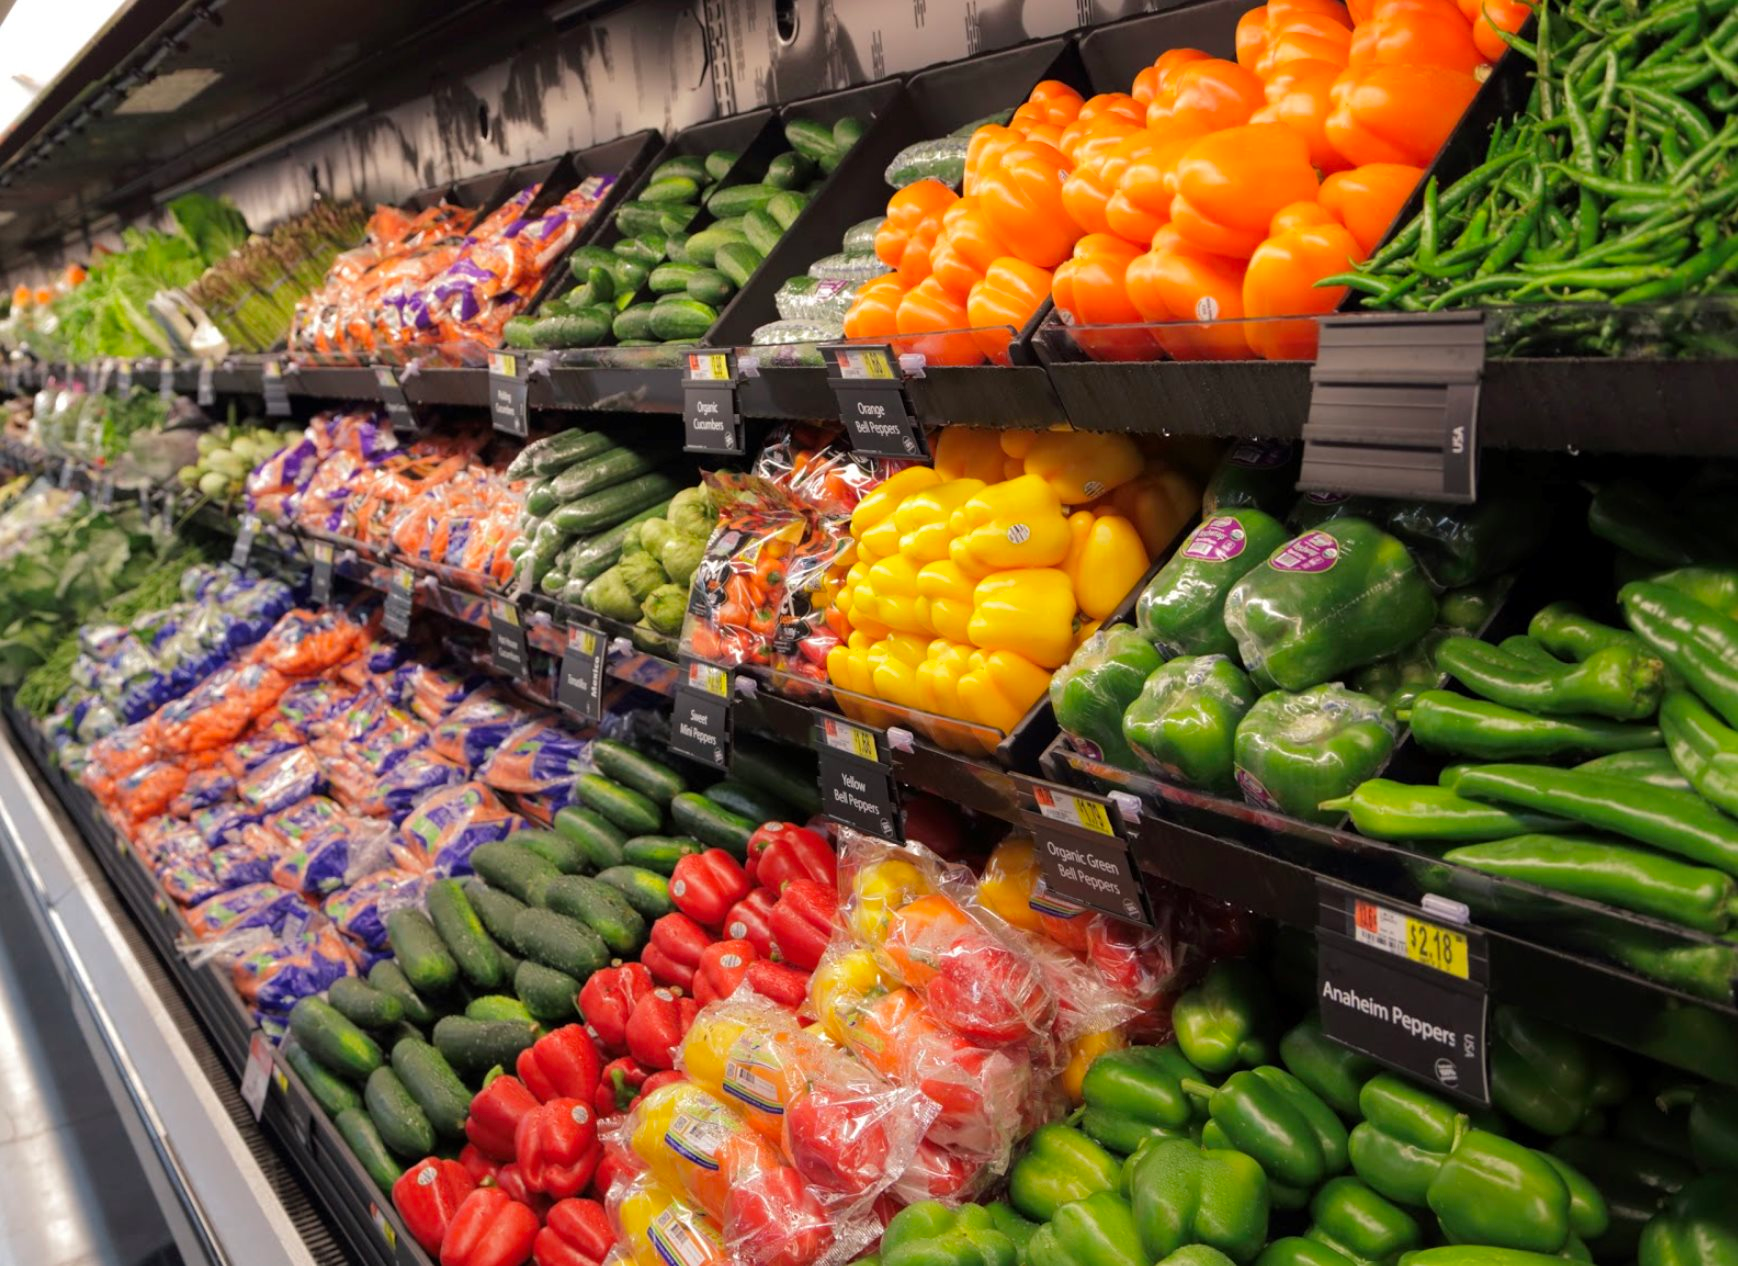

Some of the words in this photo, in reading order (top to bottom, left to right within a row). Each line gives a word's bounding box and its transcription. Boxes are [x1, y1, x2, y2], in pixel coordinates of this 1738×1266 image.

[697, 401, 719, 416] Organic
[857, 402, 885, 419] Orange
[693, 418, 724, 431] Cucumbers
[855, 420, 870, 434] Bell
[869, 421, 900, 437] Peppers
[1452, 426, 1464, 453] USA
[591, 656, 599, 698] Mexico
[693, 726, 717, 746] Peppers
[841, 772, 866, 793] Yellow
[834, 788, 848, 805] Bell
[848, 793, 880, 815] Peppers
[1047, 841, 1087, 865] Organic
[1086, 854, 1120, 876] Green
[1057, 863, 1078, 881] Bell
[1079, 869, 1121, 895] Peppers
[1410, 924, 1453, 965] $2.18
[1323, 980, 1389, 1021] Anaheim
[1392, 1006, 1456, 1047] Peppers
[1463, 1033, 1475, 1058] USA
